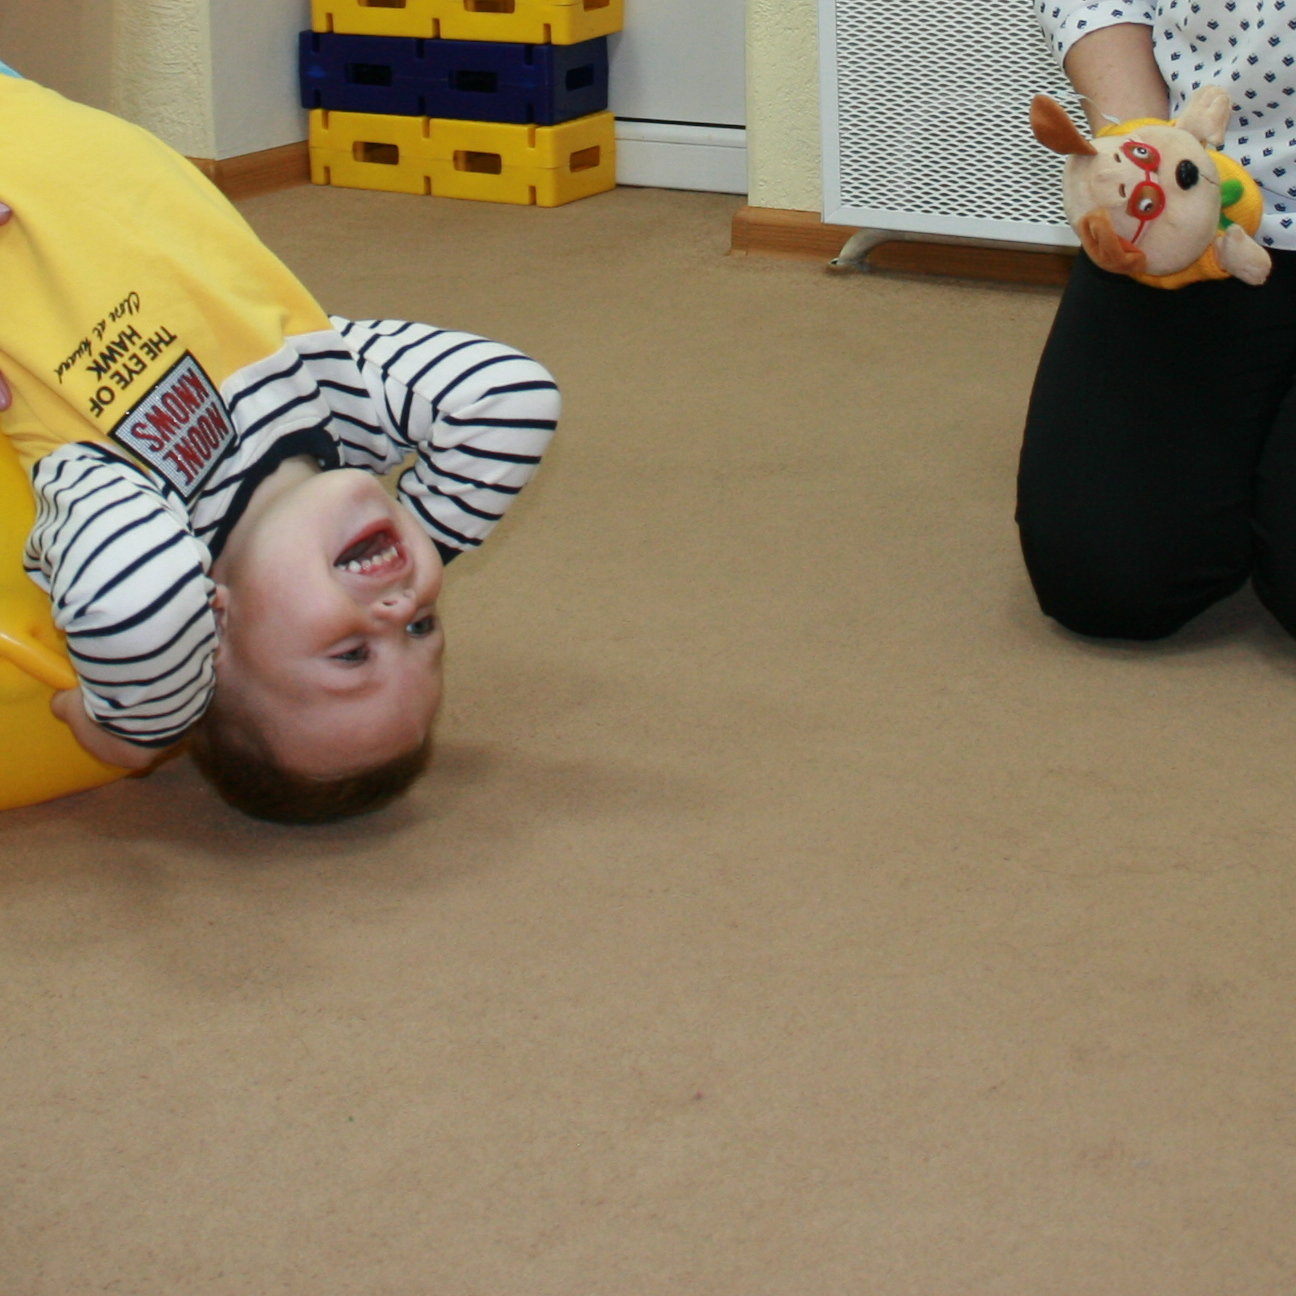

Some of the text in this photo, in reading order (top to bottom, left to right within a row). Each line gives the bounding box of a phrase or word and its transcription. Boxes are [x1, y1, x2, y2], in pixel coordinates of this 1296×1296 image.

[86, 324, 142, 381] HAWK
[89, 325, 179, 418] THE EYE OF
[131, 368, 210, 452] KNOWS
